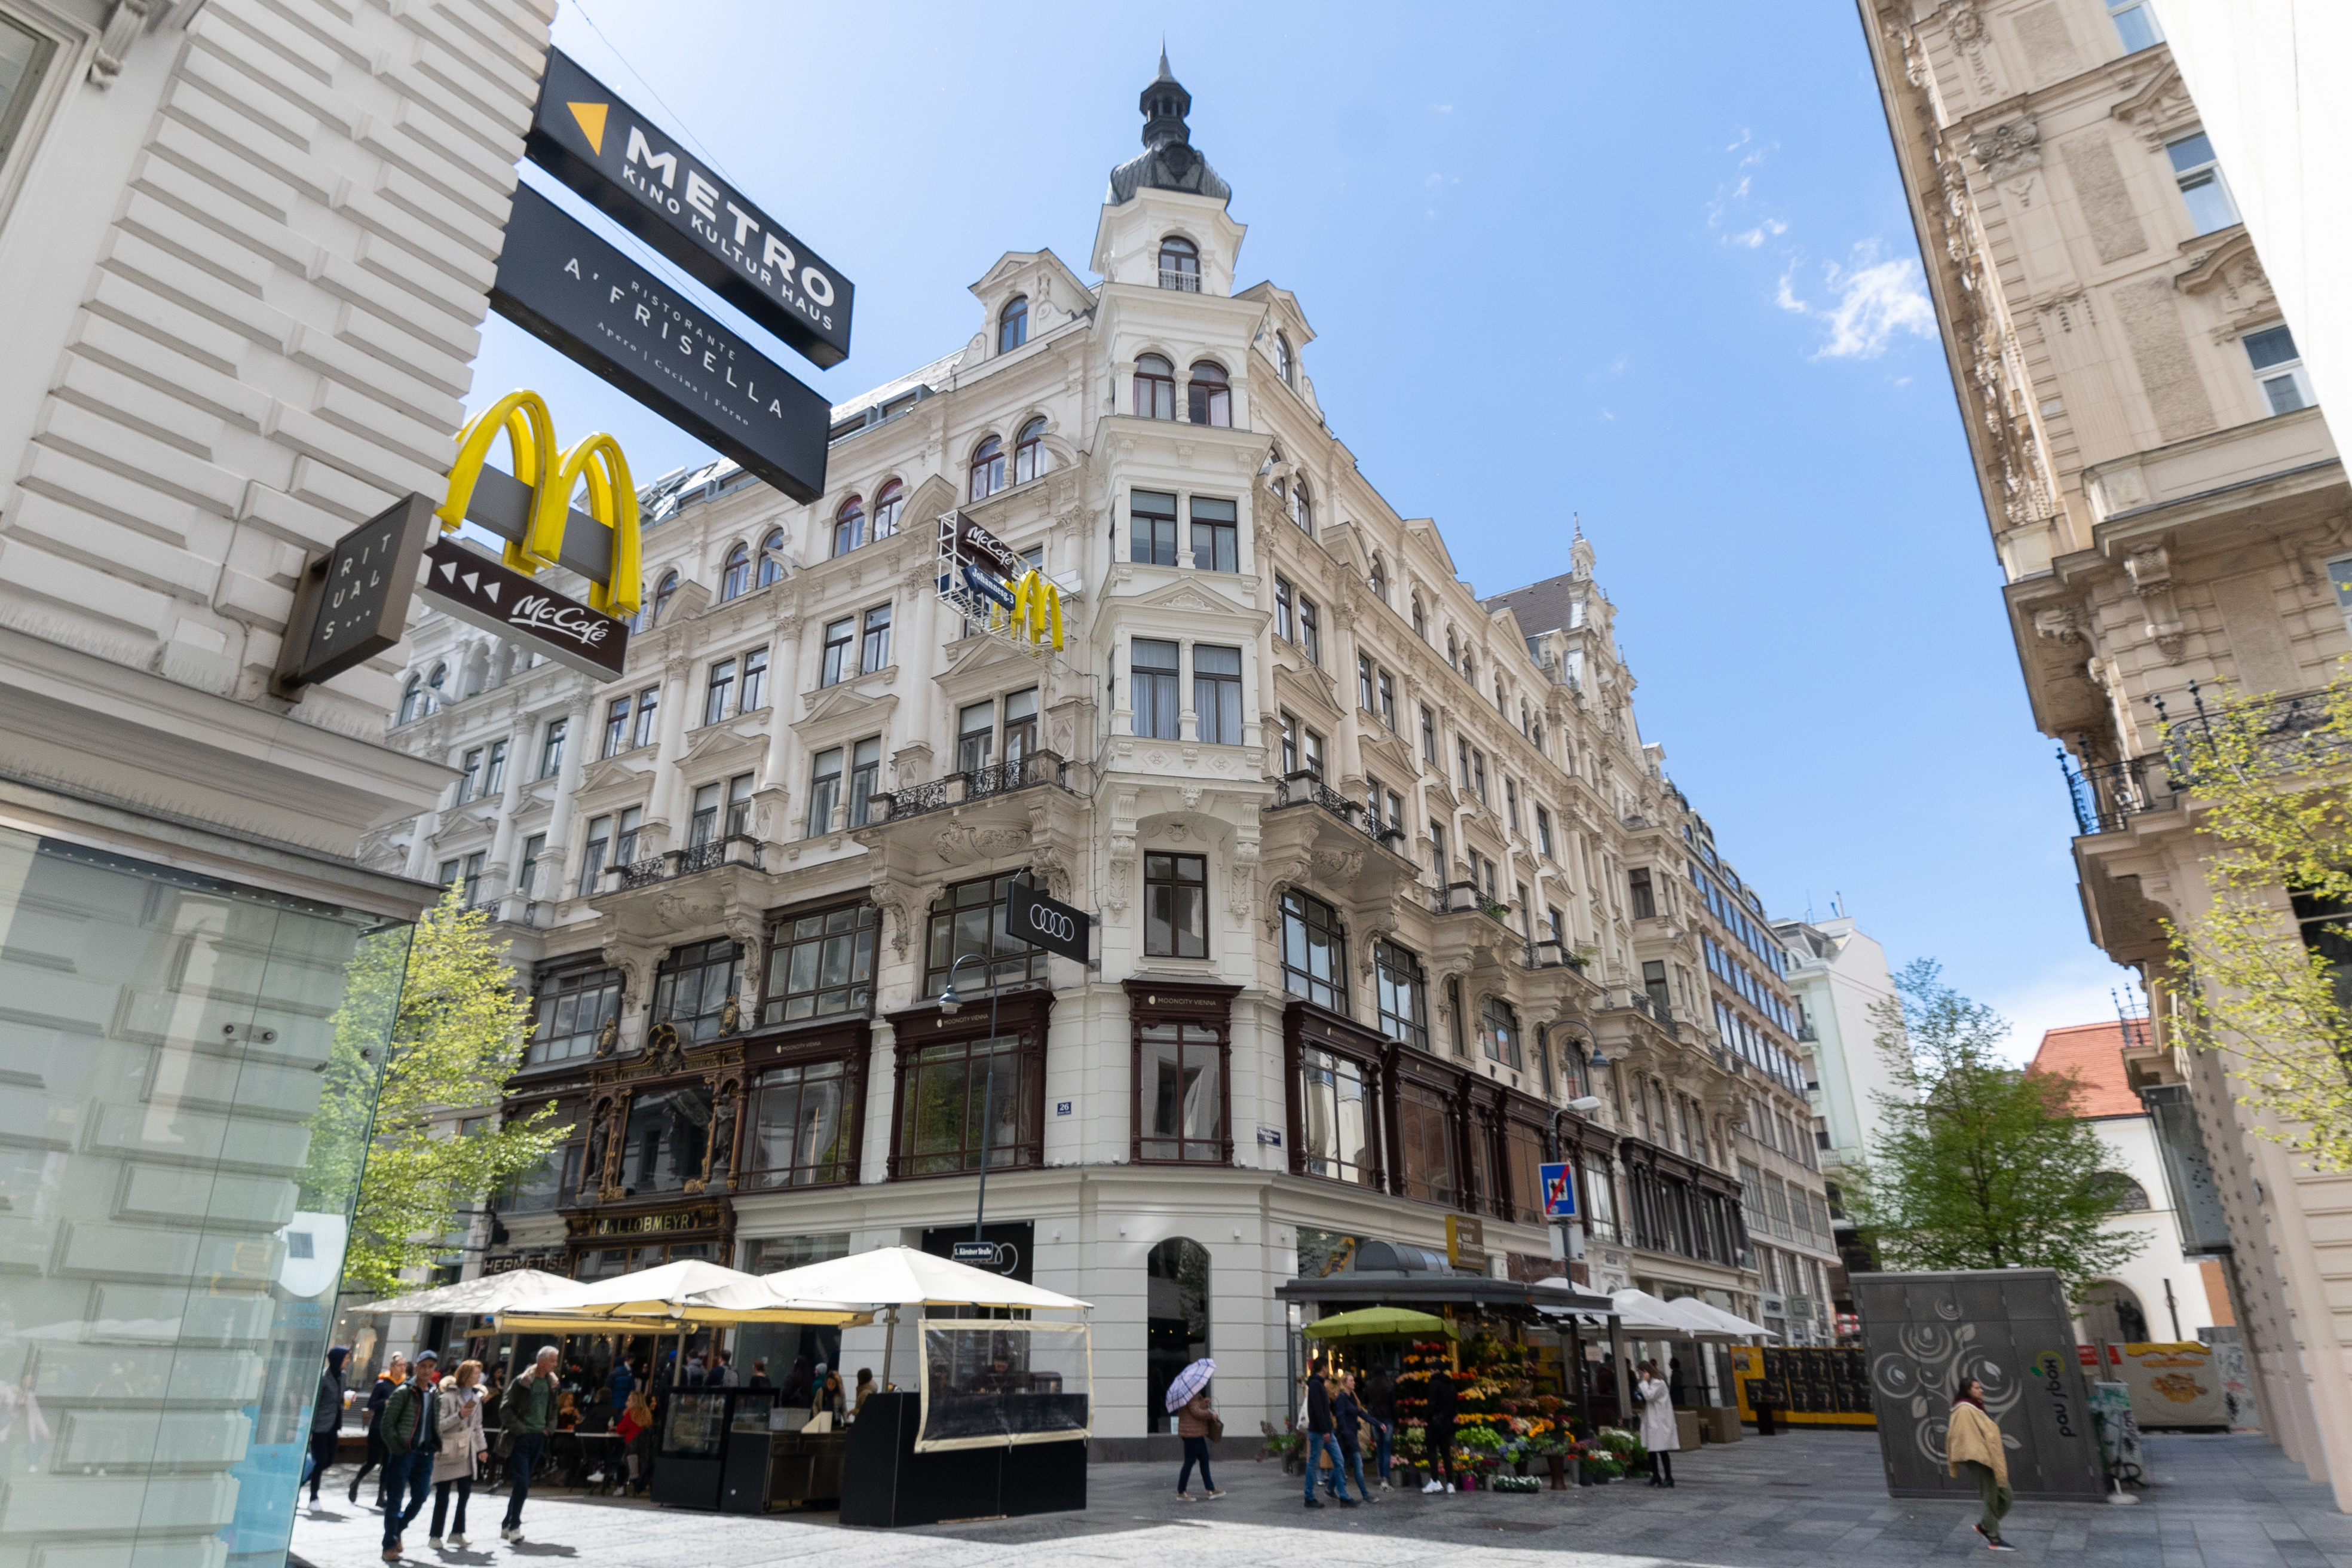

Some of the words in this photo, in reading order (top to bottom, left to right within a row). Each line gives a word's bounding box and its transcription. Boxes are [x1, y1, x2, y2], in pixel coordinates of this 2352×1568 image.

[626, 125, 835, 307] METRO
[623, 164, 681, 215] KINO
[691, 214, 772, 287] KULTUR
[782, 284, 833, 332] HAUS
[630, 280, 736, 361] RISTORANTE
[598, 321, 638, 352] Apero
[654, 359, 698, 393] Cucina
[715, 398, 749, 426] Forno
[341, 533, 391, 577] RIT
[967, 526, 1013, 565] McCafé
[332, 569, 380, 608] UAL
[512, 595, 610, 644] McCafé
[1059, 1102, 1070, 1111] 26
[627, 1214, 690, 1233] LOBMEYR
